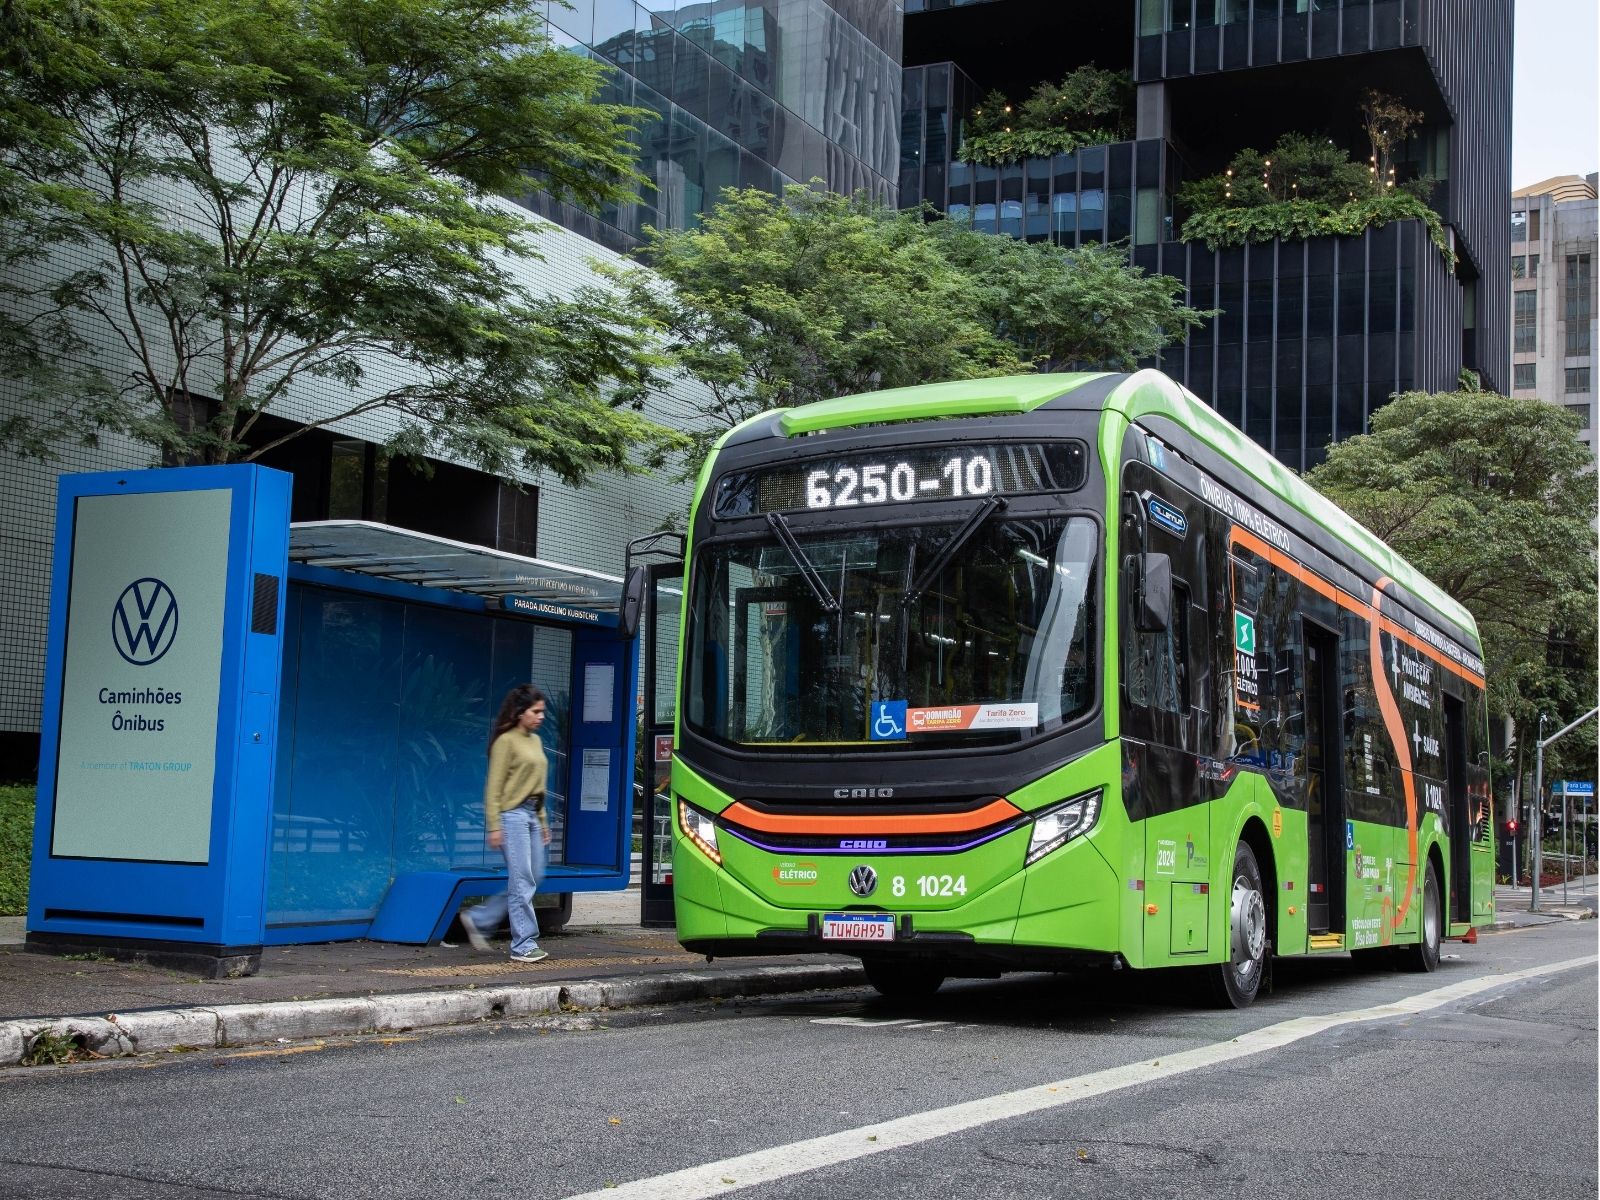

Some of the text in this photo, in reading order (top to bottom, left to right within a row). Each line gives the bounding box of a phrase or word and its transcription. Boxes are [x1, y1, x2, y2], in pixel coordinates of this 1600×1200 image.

[807, 455, 992, 508] 6250-10
[1200, 472, 1233, 515] ÔNIBUS
[1254, 513, 1290, 551] ELÉTRICO
[514, 599, 539, 610] PARADA
[539, 603, 567, 615] JUSCELINO
[1236, 653, 1257, 680] 100%
[1236, 676, 1258, 695] ELÉTRICO
[98, 687, 182, 704] Caminhões
[112, 710, 165, 731] Ônibus
[926, 708, 962, 719] DOMINGÃO
[986, 709, 1007, 717] Tarifa
[129, 761, 161, 771] TRATON
[162, 762, 193, 772] GROUP
[833, 788, 894, 798] CAIO
[839, 840, 887, 849] CAIO
[1158, 849, 1175, 867] 2024
[779, 869, 817, 879] ELÉTRICO
[892, 875, 968, 897] 8 1024
